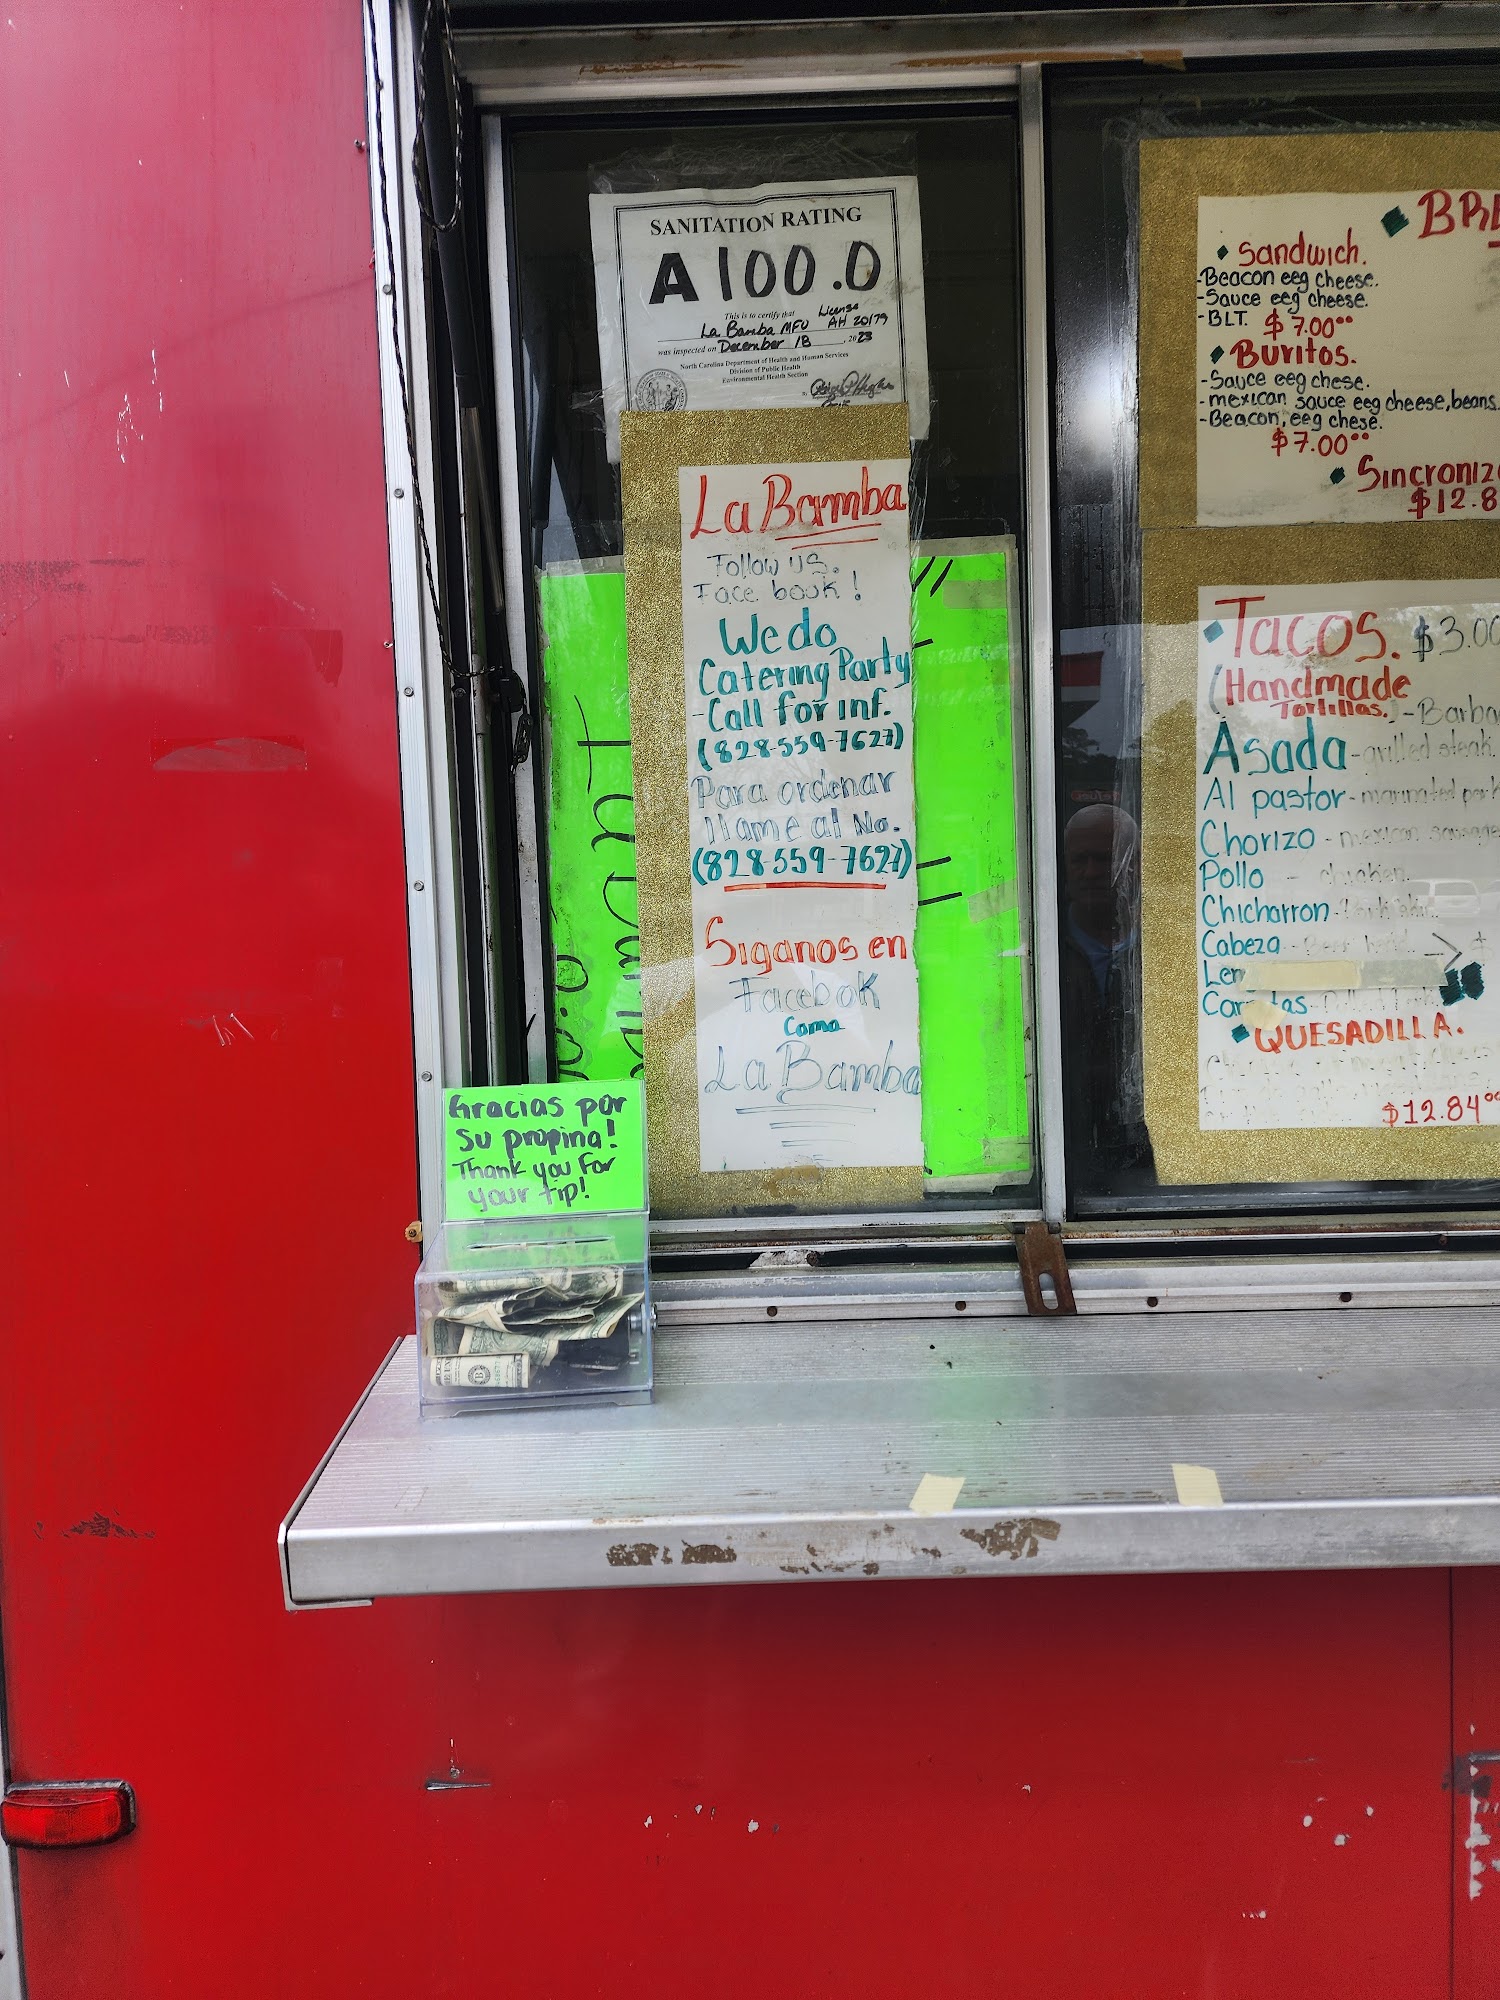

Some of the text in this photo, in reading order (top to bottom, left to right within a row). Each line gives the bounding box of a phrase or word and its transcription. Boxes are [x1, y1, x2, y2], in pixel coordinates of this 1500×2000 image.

[650, 206, 862, 236] SANITATION RATING
[648, 240, 882, 305] A 100.0
[700, 322, 721, 339] La
[726, 319, 776, 338] Bamba
[828, 313, 848, 329] AH
[757, 311, 780, 321] certify
[782, 310, 795, 318] that
[818, 302, 859, 318] License
[673, 346, 705, 357] inspected
[717, 336, 785, 353] December
[698, 360, 724, 369] Carolina
[726, 358, 761, 368] Department
[769, 356, 788, 364] Health
[789, 355, 801, 363] and
[802, 354, 824, 362] Human
[824, 351, 849, 359] Services
[722, 371, 809, 384] Environmental Health Section
[762, 365, 781, 373] Public
[781, 363, 801, 371] Health
[1296, 394, 1347, 411] sauce
[1356, 454, 1500, 493] Sincroniz
[690, 465, 908, 540] La Bamba
[706, 552, 780, 580] Follow
[719, 606, 837, 656] We do
[698, 657, 830, 703] Catering
[829, 636, 911, 689] Party
[773, 690, 829, 726] for
[1202, 716, 1347, 775] Asada
[690, 768, 897, 810] Para ordenar
[1203, 776, 1235, 811] Al
[1251, 775, 1348, 819] pastor
[703, 807, 901, 845] llame al No.
[1200, 819, 1316, 858] Chorizo
[1199, 859, 1264, 892] Pollo
[705, 915, 907, 976] Siganos en
[1201, 929, 1281, 958] Cabeza
[1202, 990, 1308, 1019] Cartas
[704, 1039, 921, 1105] La Bamba
[448, 1093, 628, 1127] Gracias por
[501, 1118, 619, 1159] propina!
[452, 1157, 527, 1181] Thank
[532, 1160, 572, 1188] you
[467, 1176, 591, 1213] your tip!
